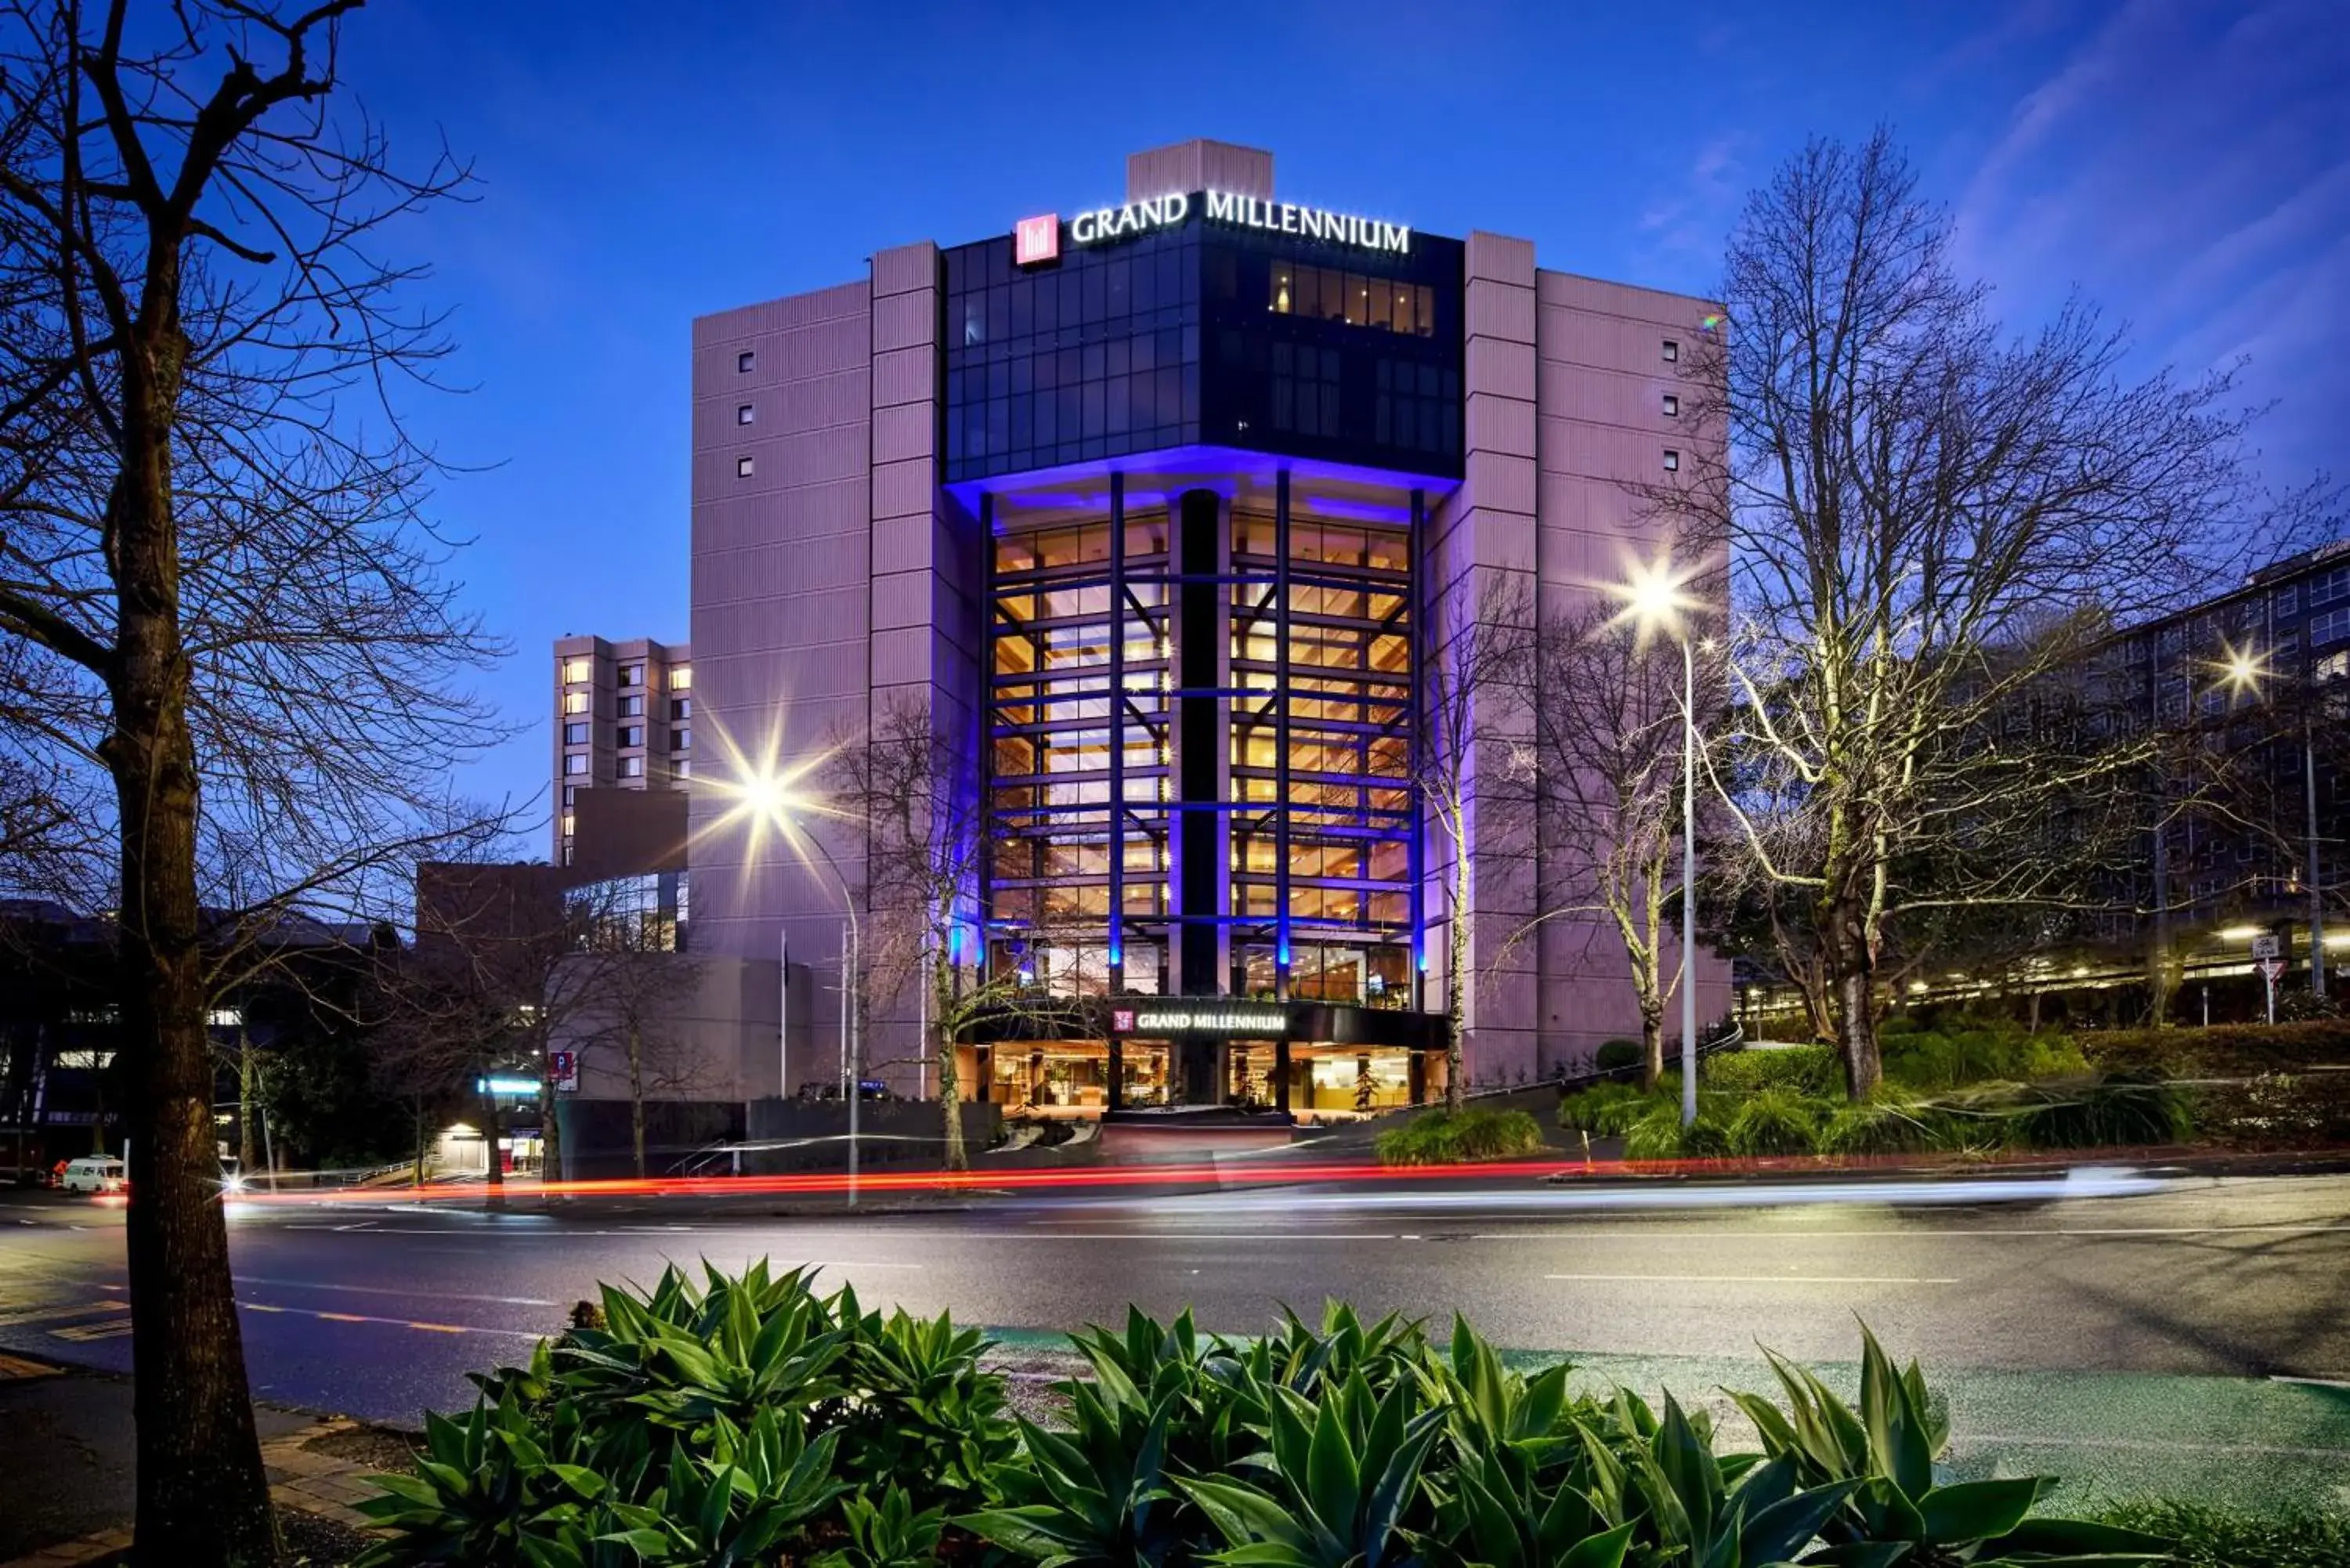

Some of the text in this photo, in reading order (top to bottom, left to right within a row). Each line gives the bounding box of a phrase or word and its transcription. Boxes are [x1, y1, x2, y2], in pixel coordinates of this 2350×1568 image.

[1072, 189, 1409, 254] GRAND MILLENNIUM
[1137, 1013, 1285, 1030] GRAND MILLENNIUM
